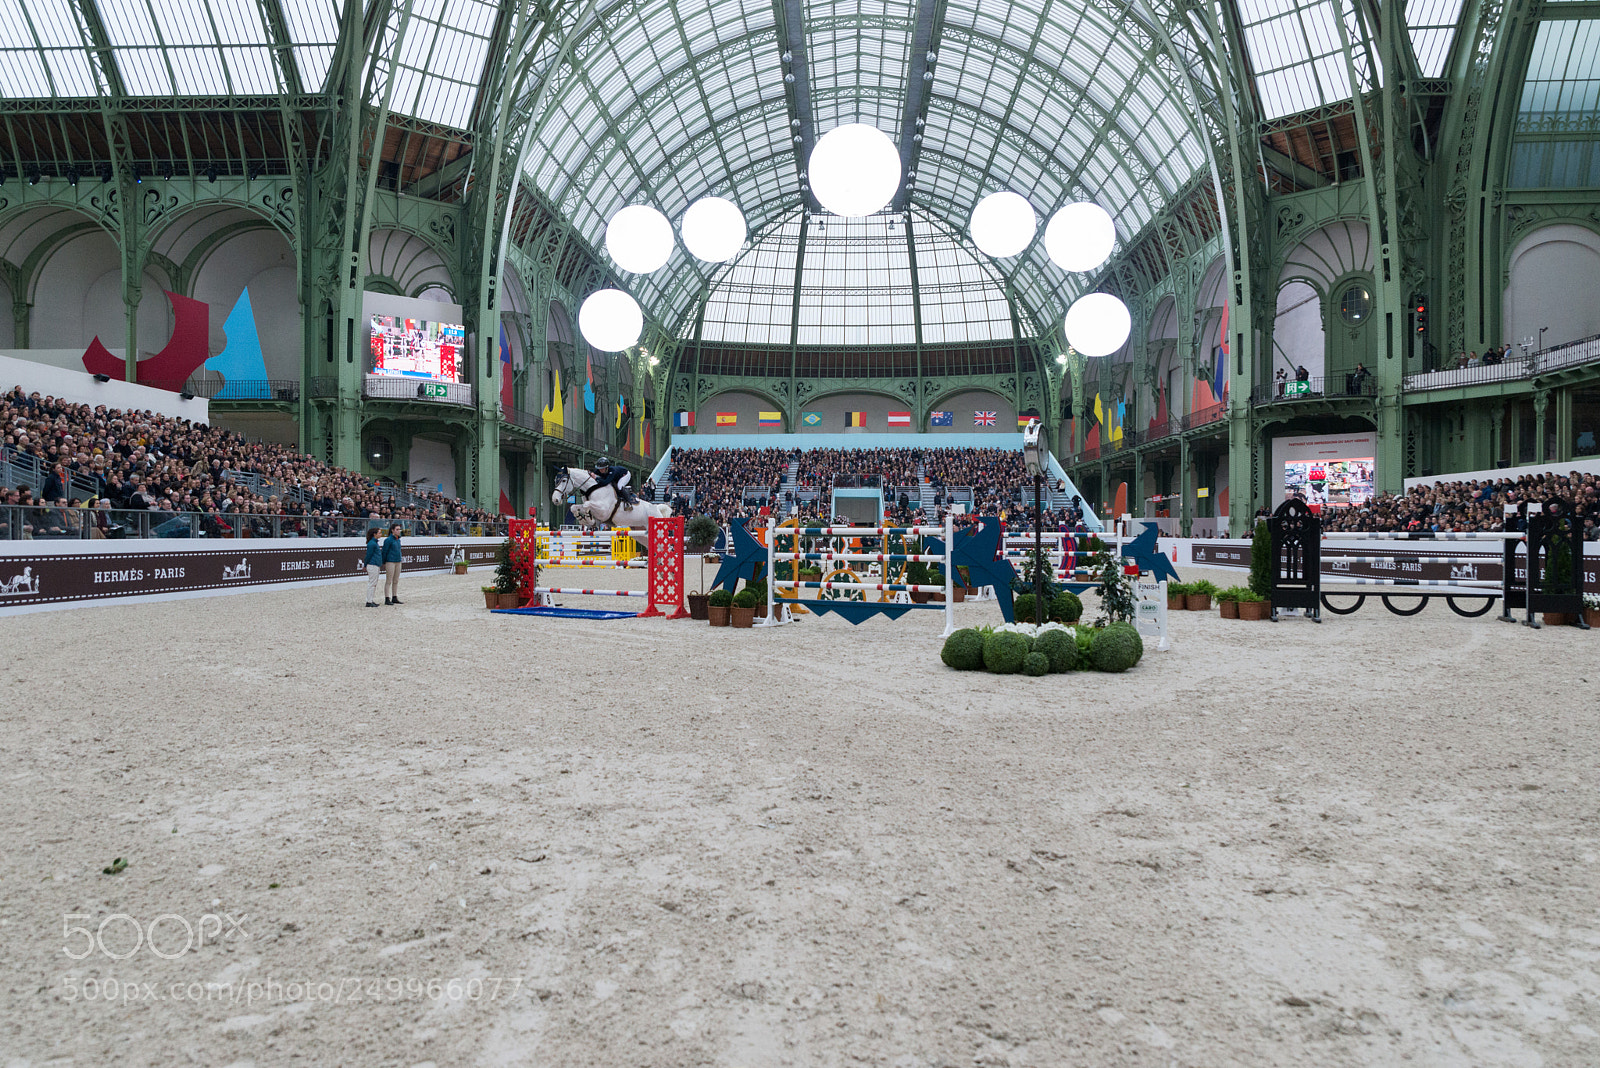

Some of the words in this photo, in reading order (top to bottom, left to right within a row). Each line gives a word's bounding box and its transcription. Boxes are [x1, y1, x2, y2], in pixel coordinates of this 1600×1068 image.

[281, 560, 310, 571] HERMÈS
[316, 559, 335, 570] PARIS
[1402, 562, 1422, 572] PARIS
[94, 568, 144, 583] HERMÈS
[154, 567, 186, 580] PARIS
